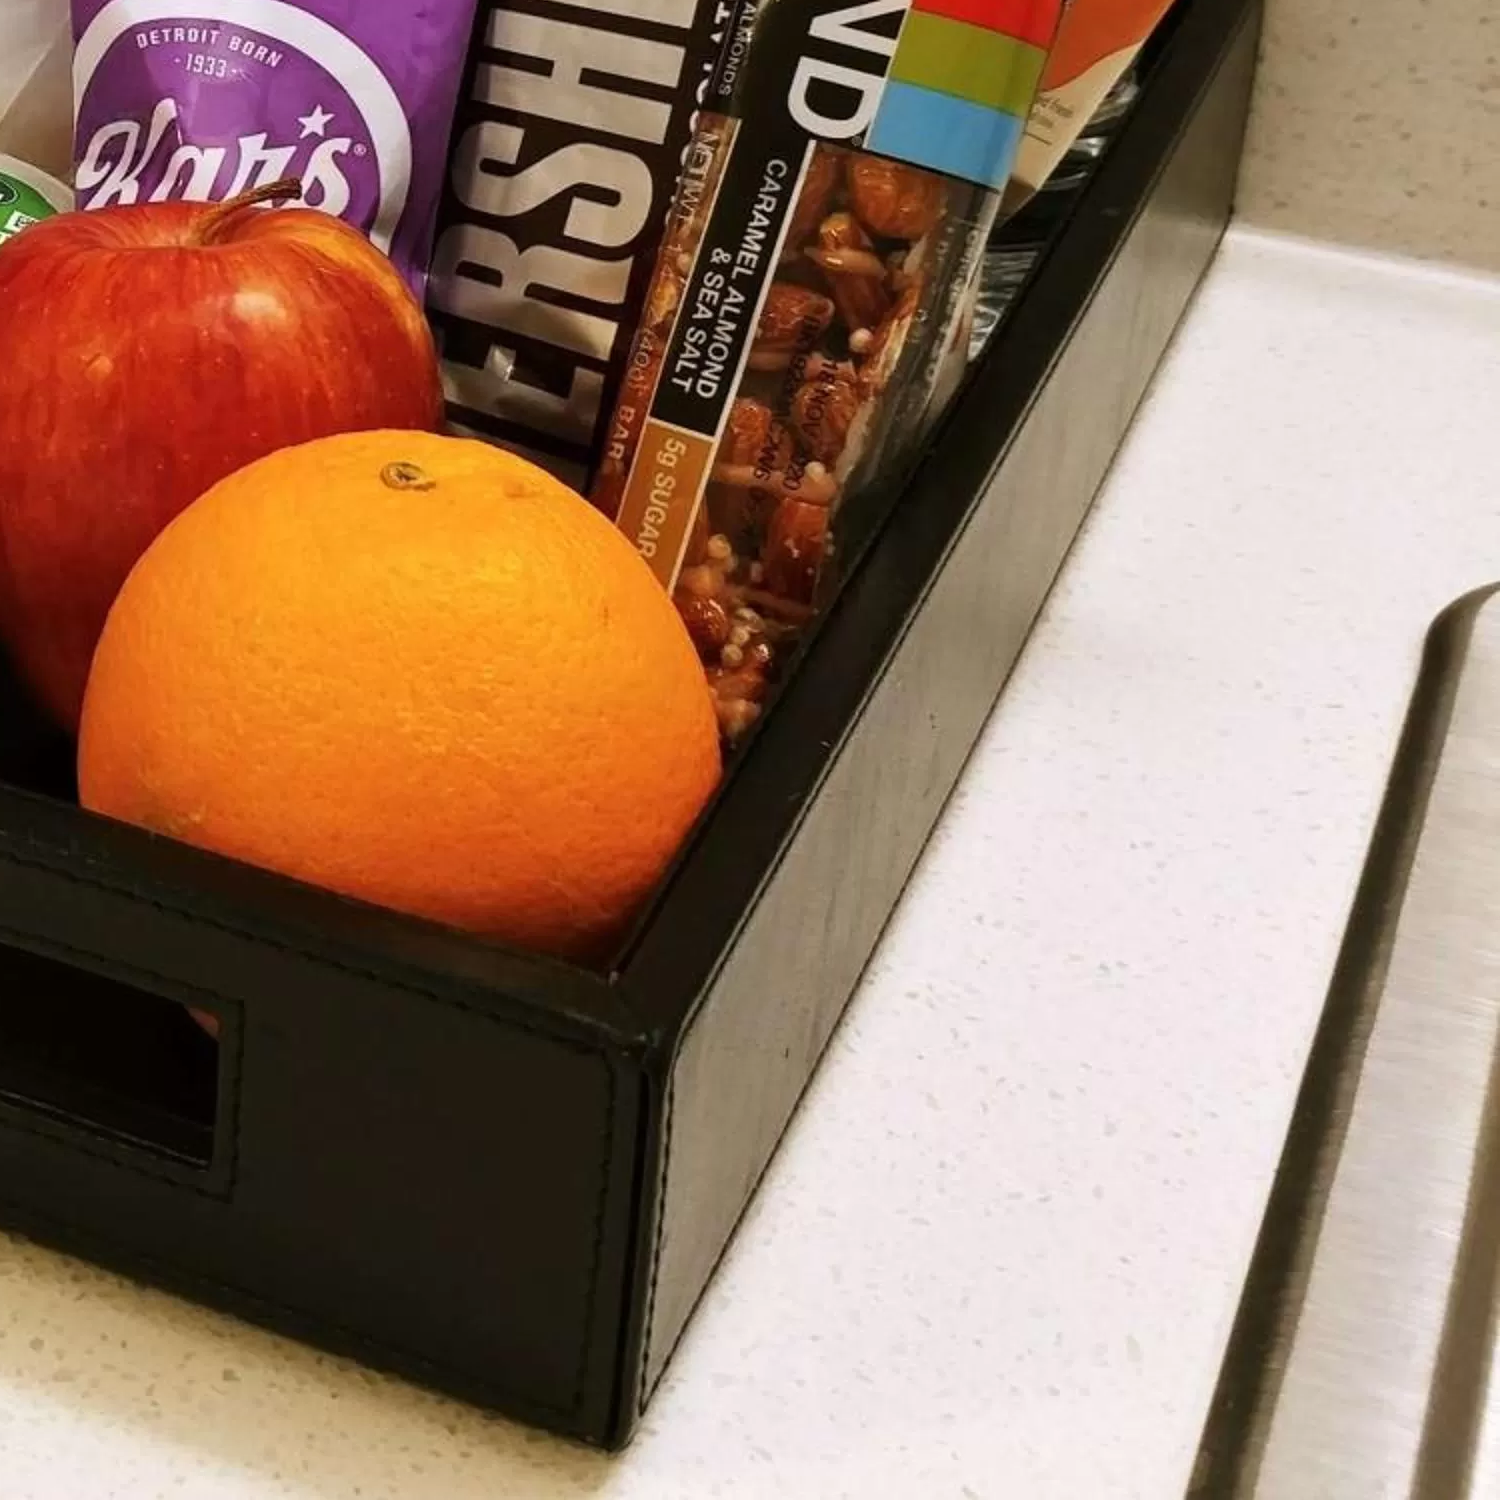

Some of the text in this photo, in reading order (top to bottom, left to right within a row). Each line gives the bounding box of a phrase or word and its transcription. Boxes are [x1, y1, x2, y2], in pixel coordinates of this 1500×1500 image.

[136, 26, 283, 68] DETROIT BORN
[184, 52, 227, 78] 1933
[718, 2, 759, 96] ALMONDS
[731, 158, 789, 281] CARAMEL
[671, 247, 733, 393] & SEA SALT
[695, 286, 746, 400] ALMOND
[607, 404, 636, 461] BAR
[635, 437, 687, 559] 5g SUGAR
